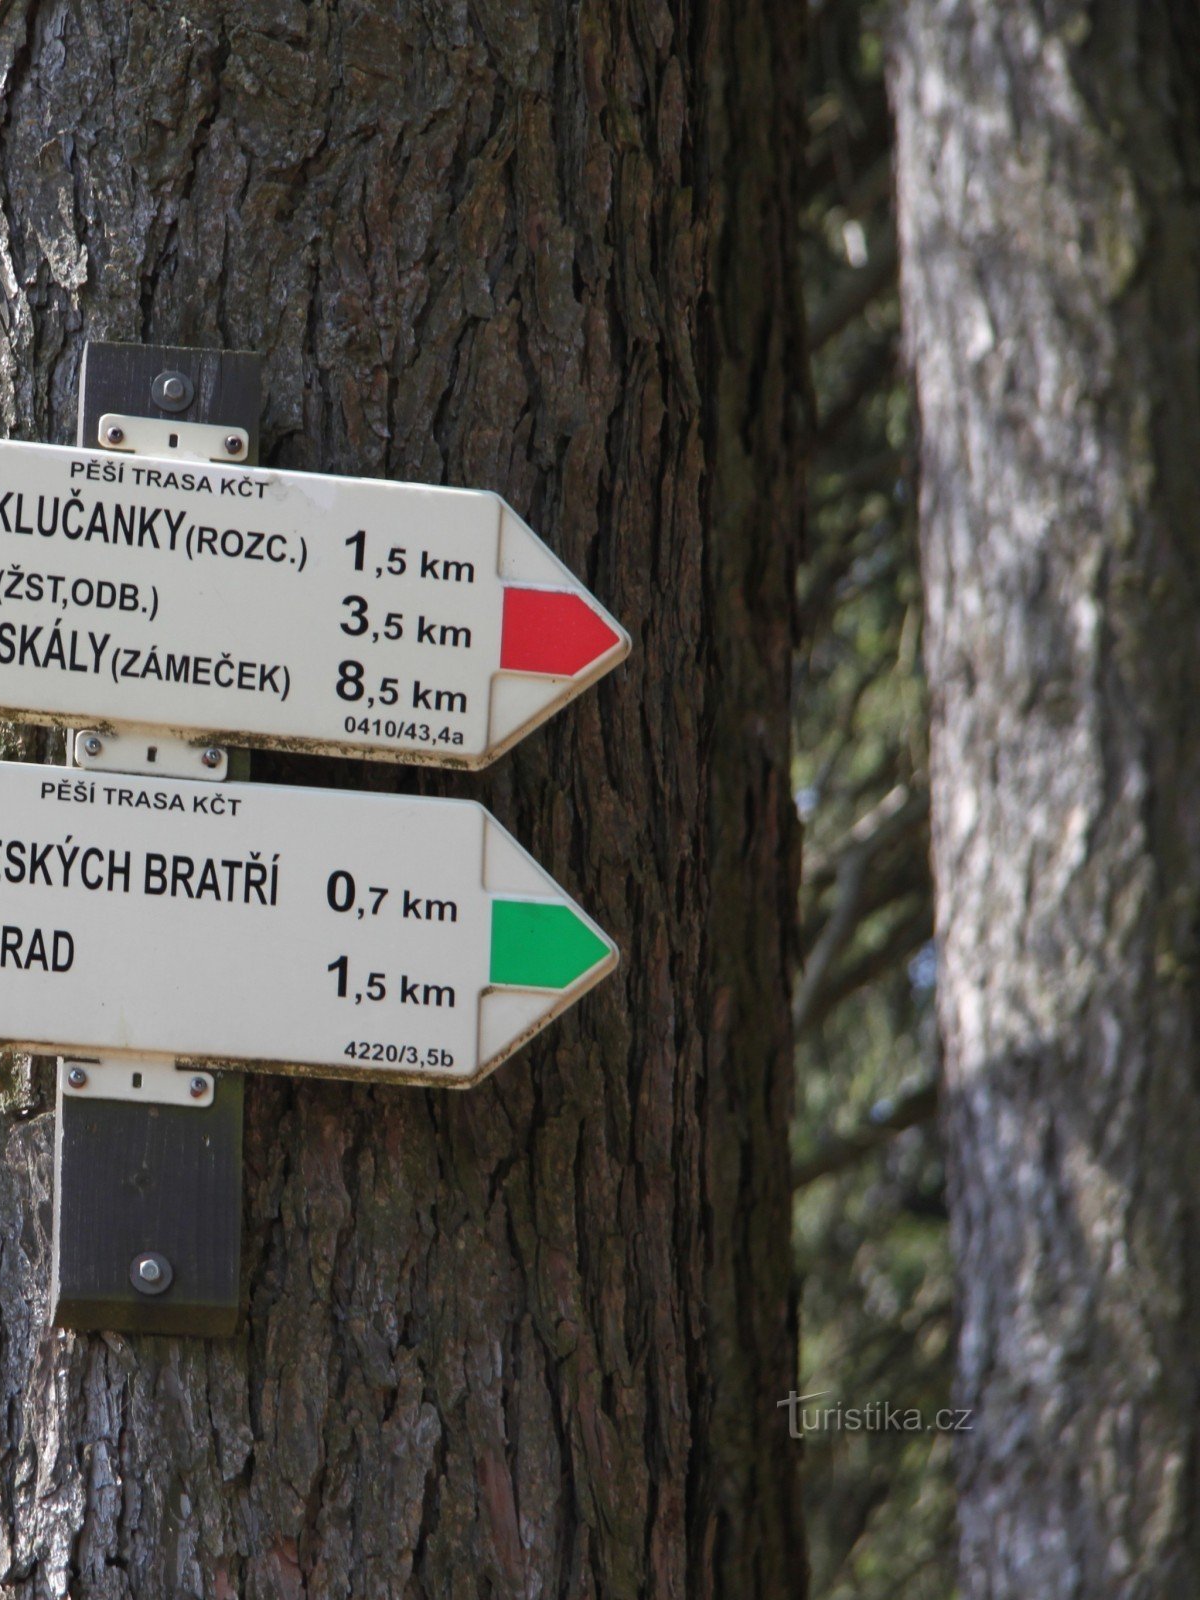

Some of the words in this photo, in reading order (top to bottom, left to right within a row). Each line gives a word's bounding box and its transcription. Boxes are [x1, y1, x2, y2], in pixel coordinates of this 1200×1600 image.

[70, 459, 125, 484] PĚŠÍ
[131, 467, 213, 494] TRASA
[220, 476, 270, 499] KČT
[345, 529, 407, 579] 1,5
[420, 550, 475, 584] km
[339, 594, 404, 644] 3,5
[416, 615, 472, 649] km
[335, 659, 399, 709] 8,5
[412, 680, 467, 714] km
[344, 715, 464, 746] 0410/43,4a
[40, 778, 96, 804] PĚŠÍ
[102, 787, 186, 812] TRASA
[193, 792, 242, 817] KČT
[143, 850, 280, 907] BRATŘÍ
[326, 869, 389, 920] 0,7
[402, 889, 458, 923] km
[327, 955, 387, 1006] 1,5
[400, 974, 456, 1008] km
[343, 1040, 454, 1069] 4220/3,5b
